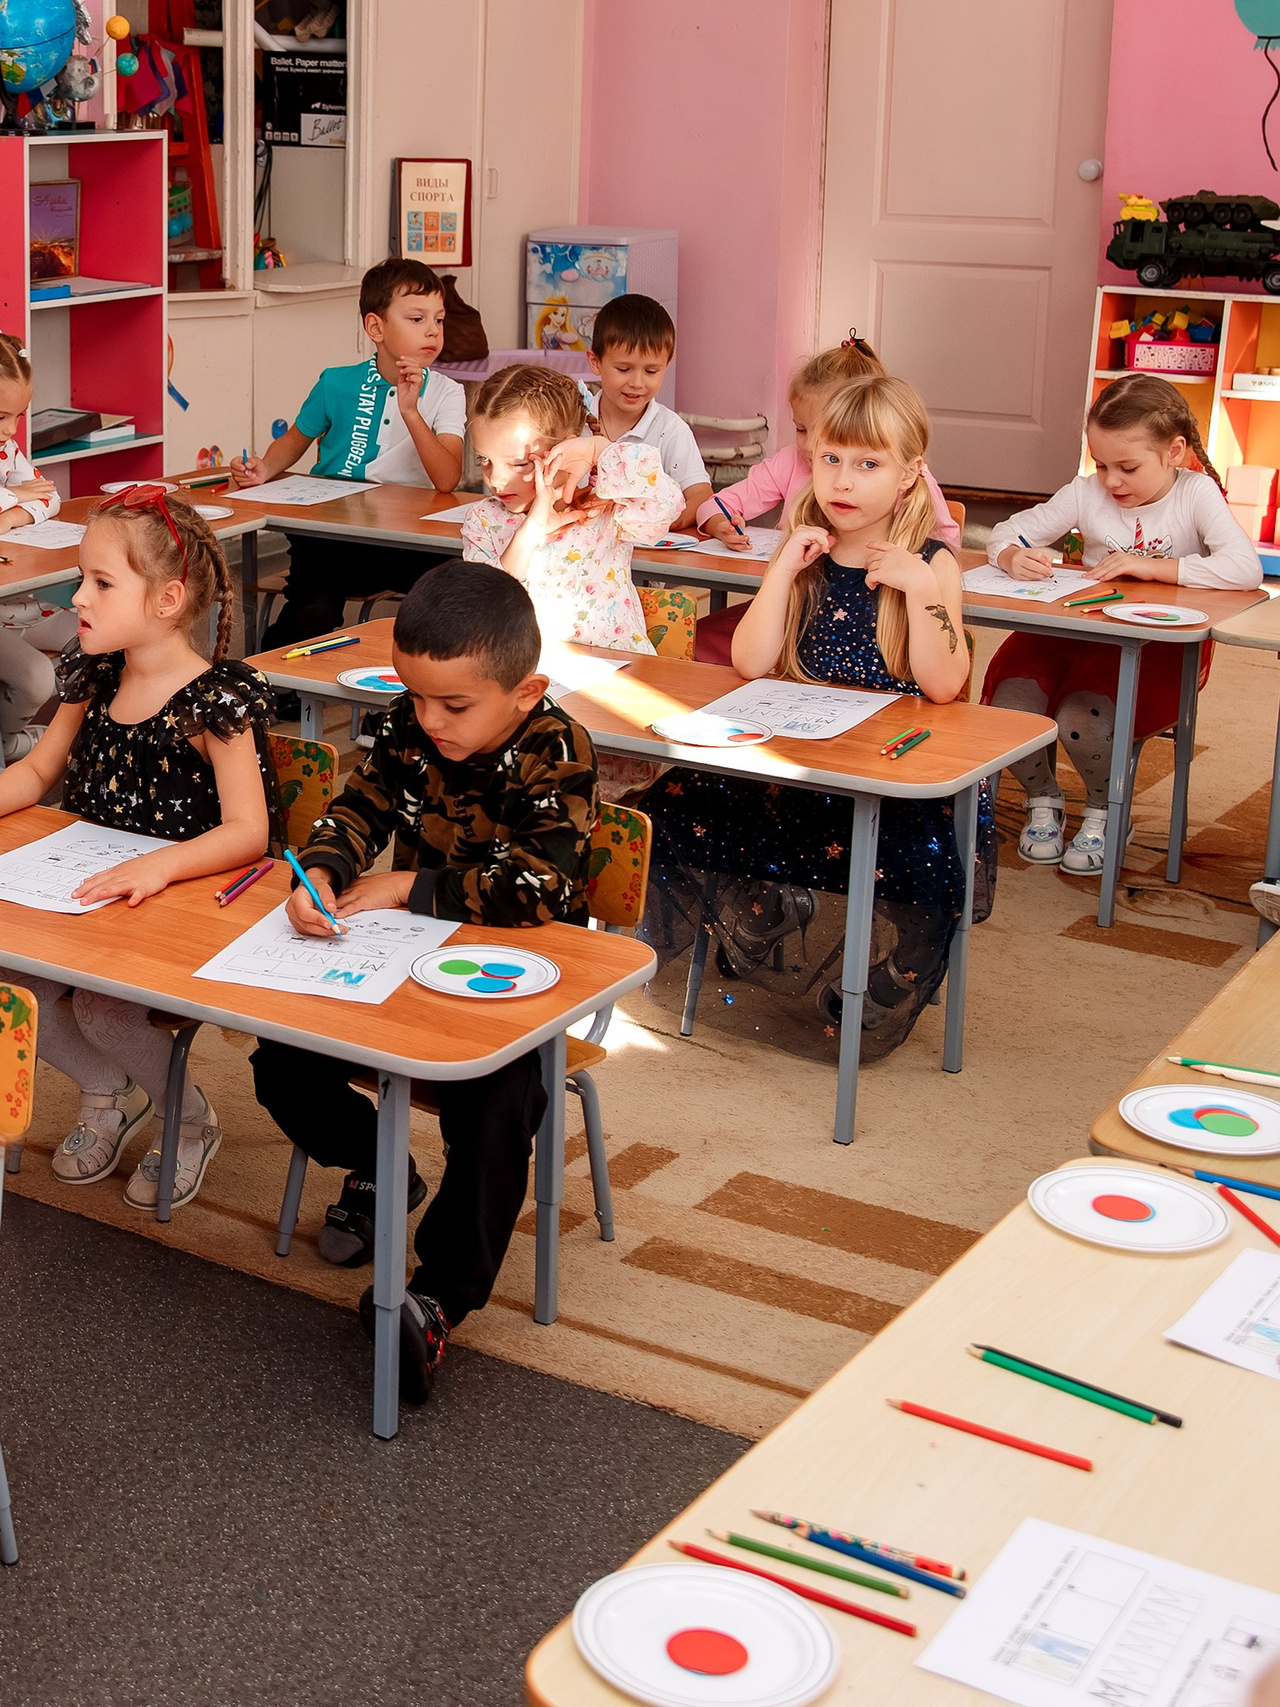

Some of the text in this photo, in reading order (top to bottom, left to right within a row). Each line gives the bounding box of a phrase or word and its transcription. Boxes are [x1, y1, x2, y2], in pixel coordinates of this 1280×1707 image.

[295, 58, 319, 67] Paper
[416, 178, 449, 189] ВИДЫ
[410, 191, 454, 202] СПОРТА
[357, 383, 377, 416] STAY
